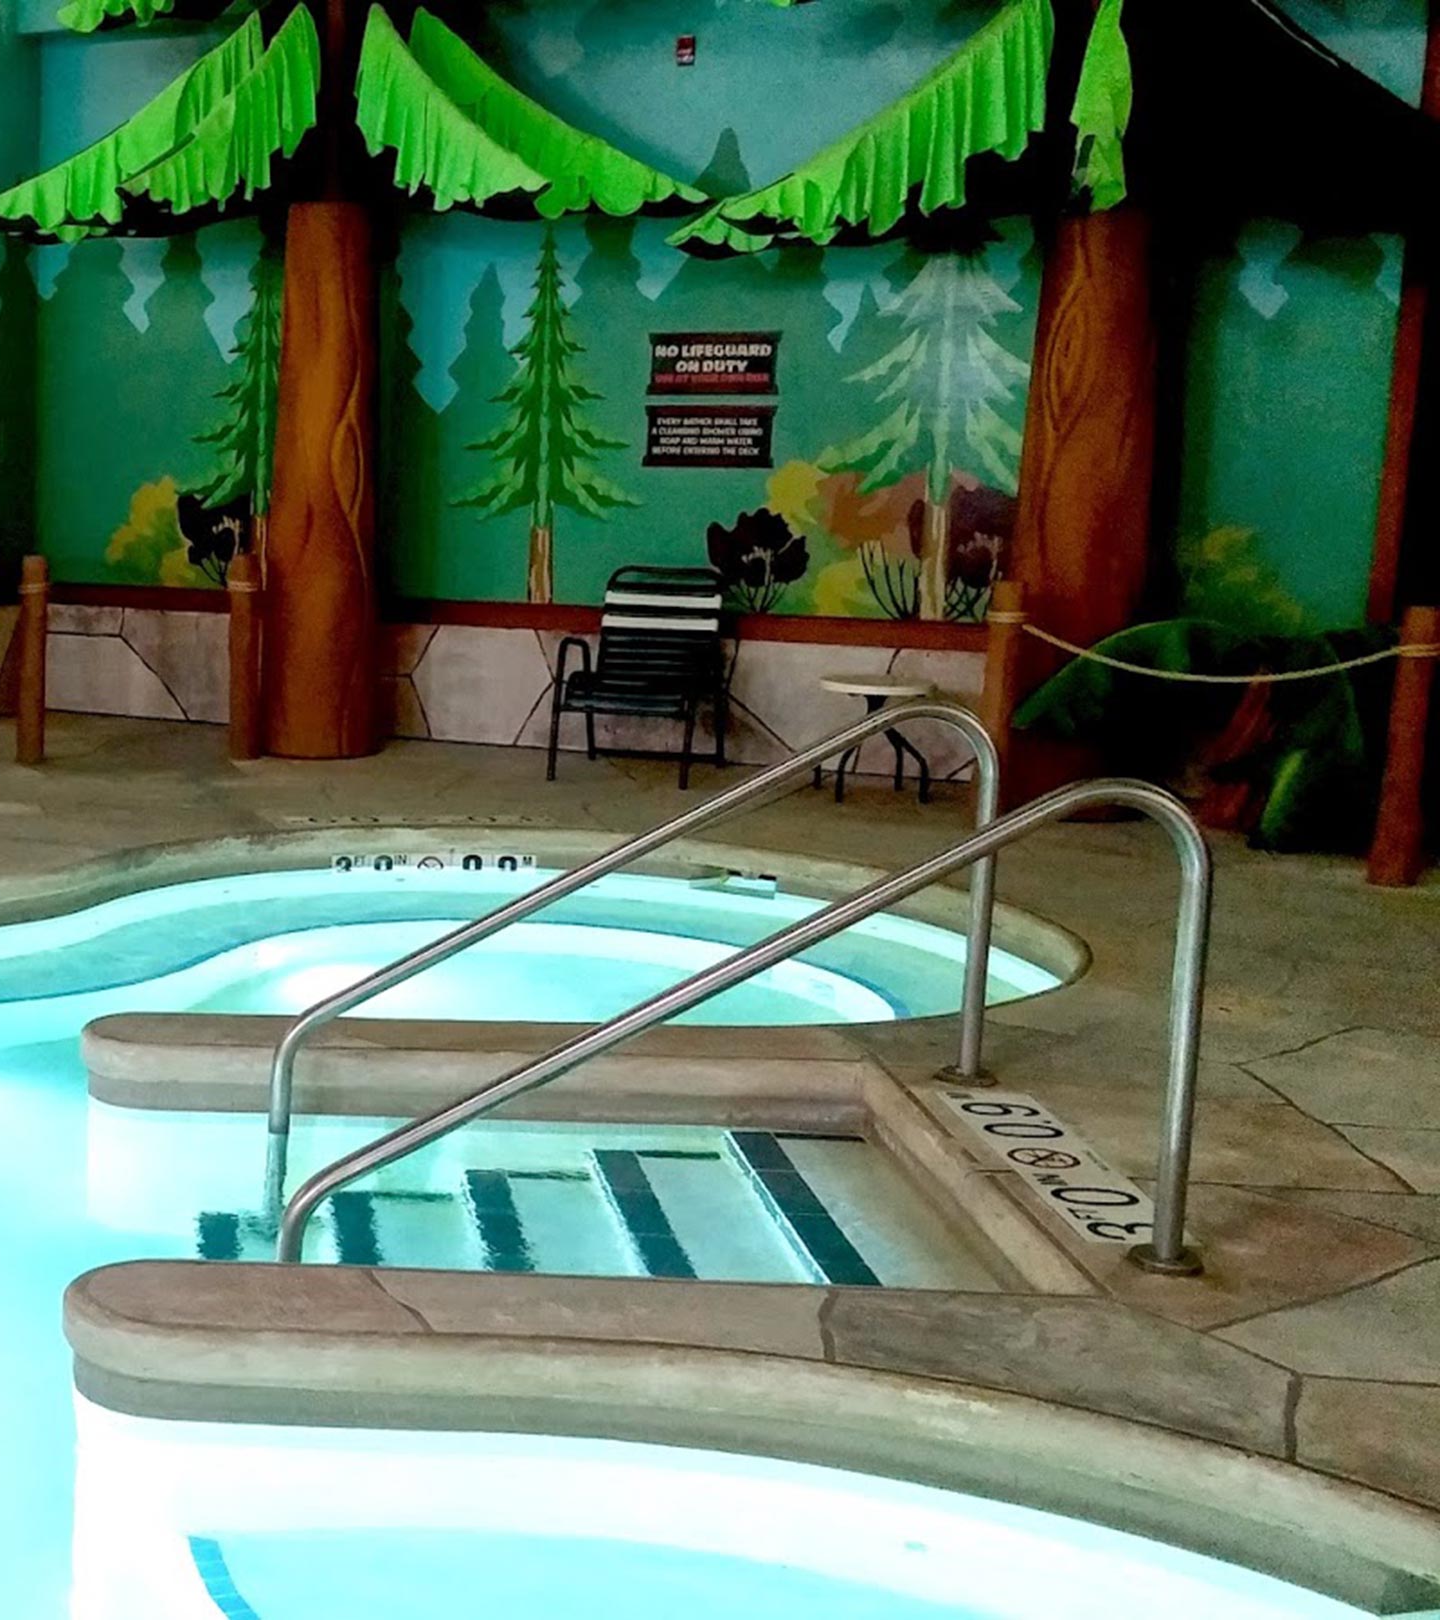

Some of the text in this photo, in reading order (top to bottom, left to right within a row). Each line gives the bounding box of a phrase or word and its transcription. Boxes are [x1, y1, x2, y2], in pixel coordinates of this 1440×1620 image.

[654, 344, 772, 357] NO LIFEGUARD
[675, 360, 748, 372] ON DUTY
[657, 417, 681, 426] EVERY
[714, 417, 737, 426] SHALL
[739, 417, 758, 426] TAKE
[651, 427, 763, 436] A CLEANSING SHOWER USING
[660, 437, 753, 445] SOAP AND WARM WATER
[652, 446, 760, 455] BEFORE ENTERING THE DECK
[394, 855, 407, 865] IN
[523, 857, 533, 866] M
[1050, 1187, 1140, 1207] 0
